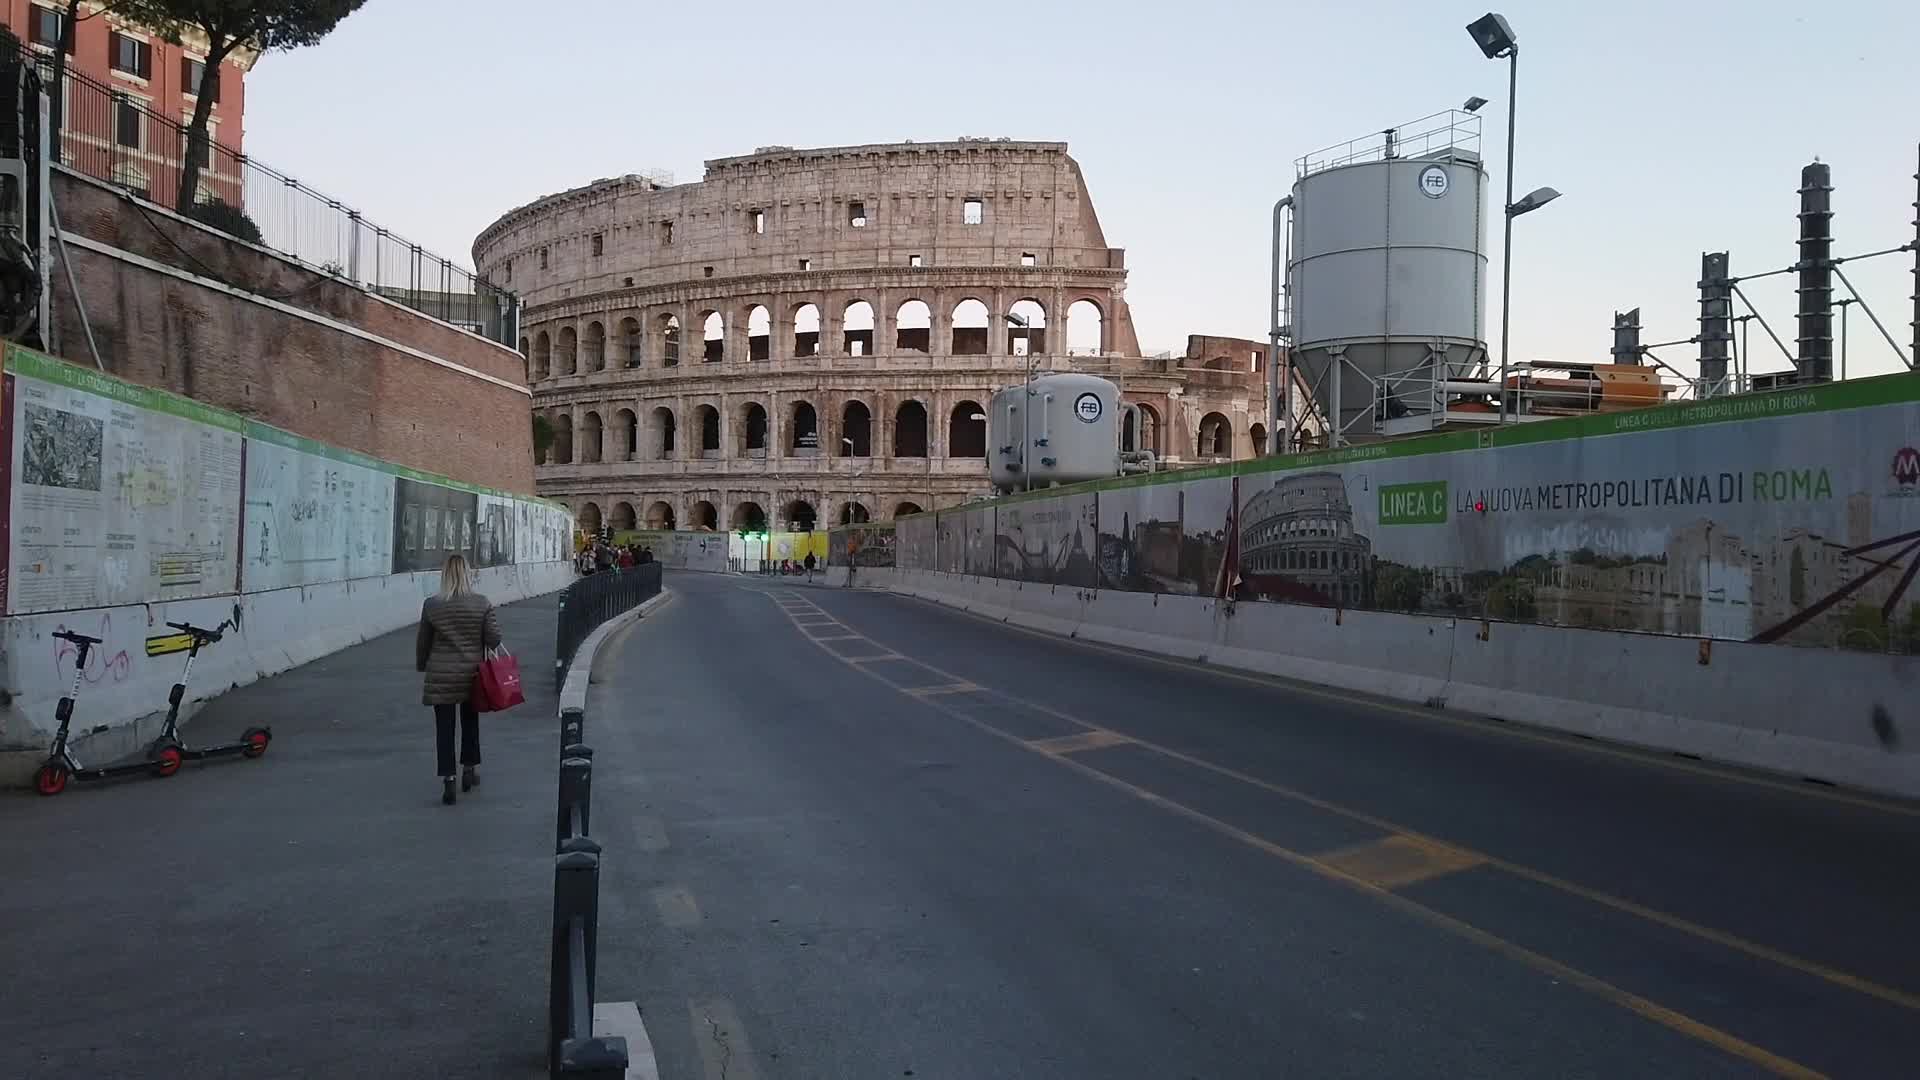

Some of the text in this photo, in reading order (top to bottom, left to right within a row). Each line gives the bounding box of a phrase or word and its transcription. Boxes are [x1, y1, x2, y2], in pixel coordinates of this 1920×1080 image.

[1615, 415, 1640, 429] LINEA
[1642, 413, 1649, 426] C
[1681, 401, 1766, 421] METROPOLITANA
[1768, 398, 1780, 410] DI
[1783, 394, 1817, 410] ROMA
[1381, 489, 1444, 518] LINEA C
[1456, 468, 1833, 513] LA NUOVA METROPOLITANA DI ROMA
